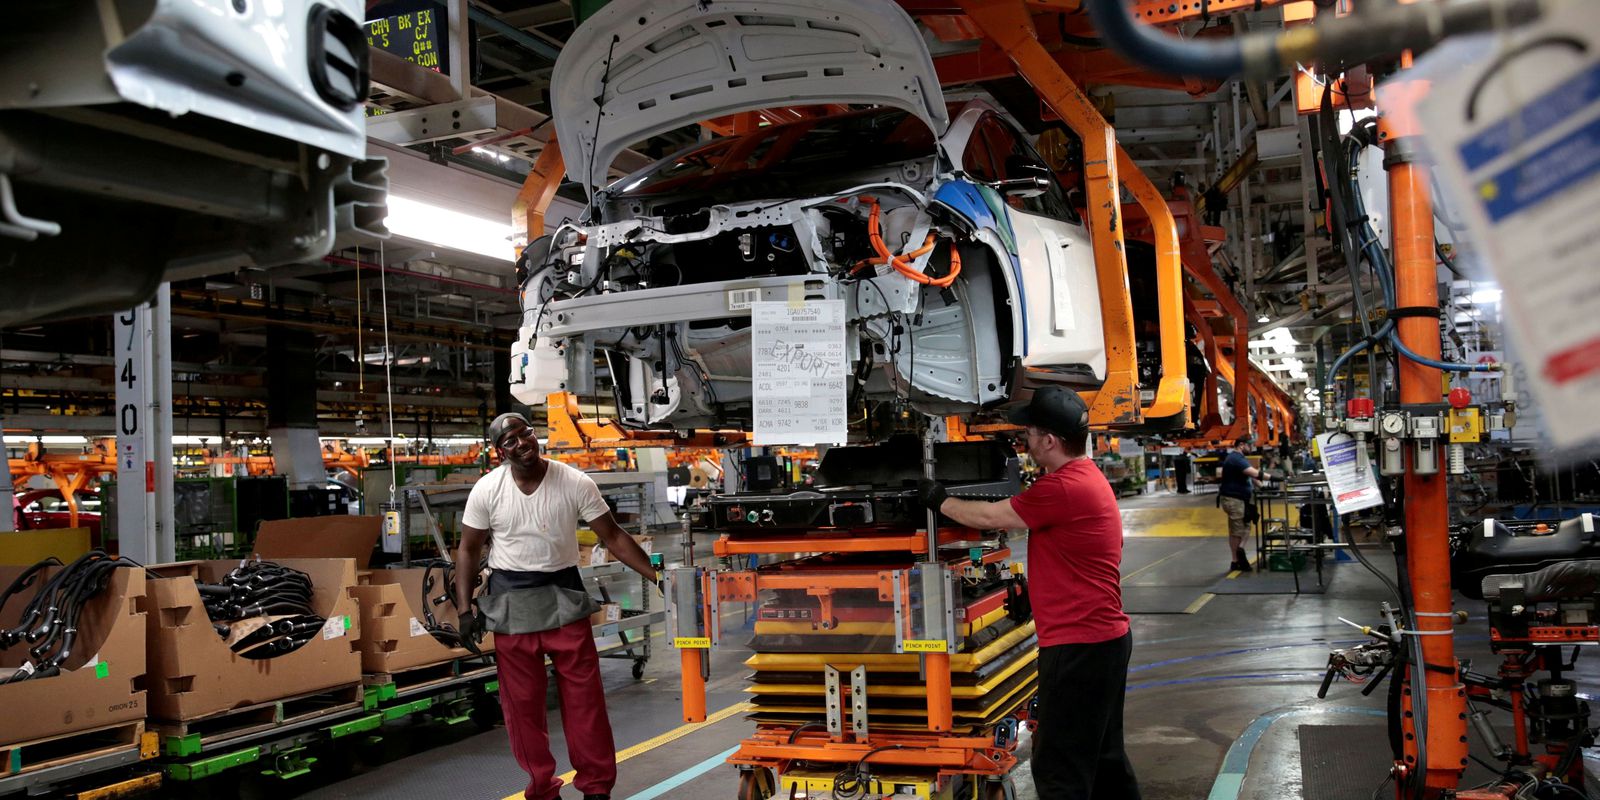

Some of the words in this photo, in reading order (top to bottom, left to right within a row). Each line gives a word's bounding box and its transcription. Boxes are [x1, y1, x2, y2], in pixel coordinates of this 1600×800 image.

[371, 19, 390, 35] CH4
[398, 14, 412, 30] BK
[417, 10, 431, 26] EX
[771, 340, 832, 379] EXPORT
